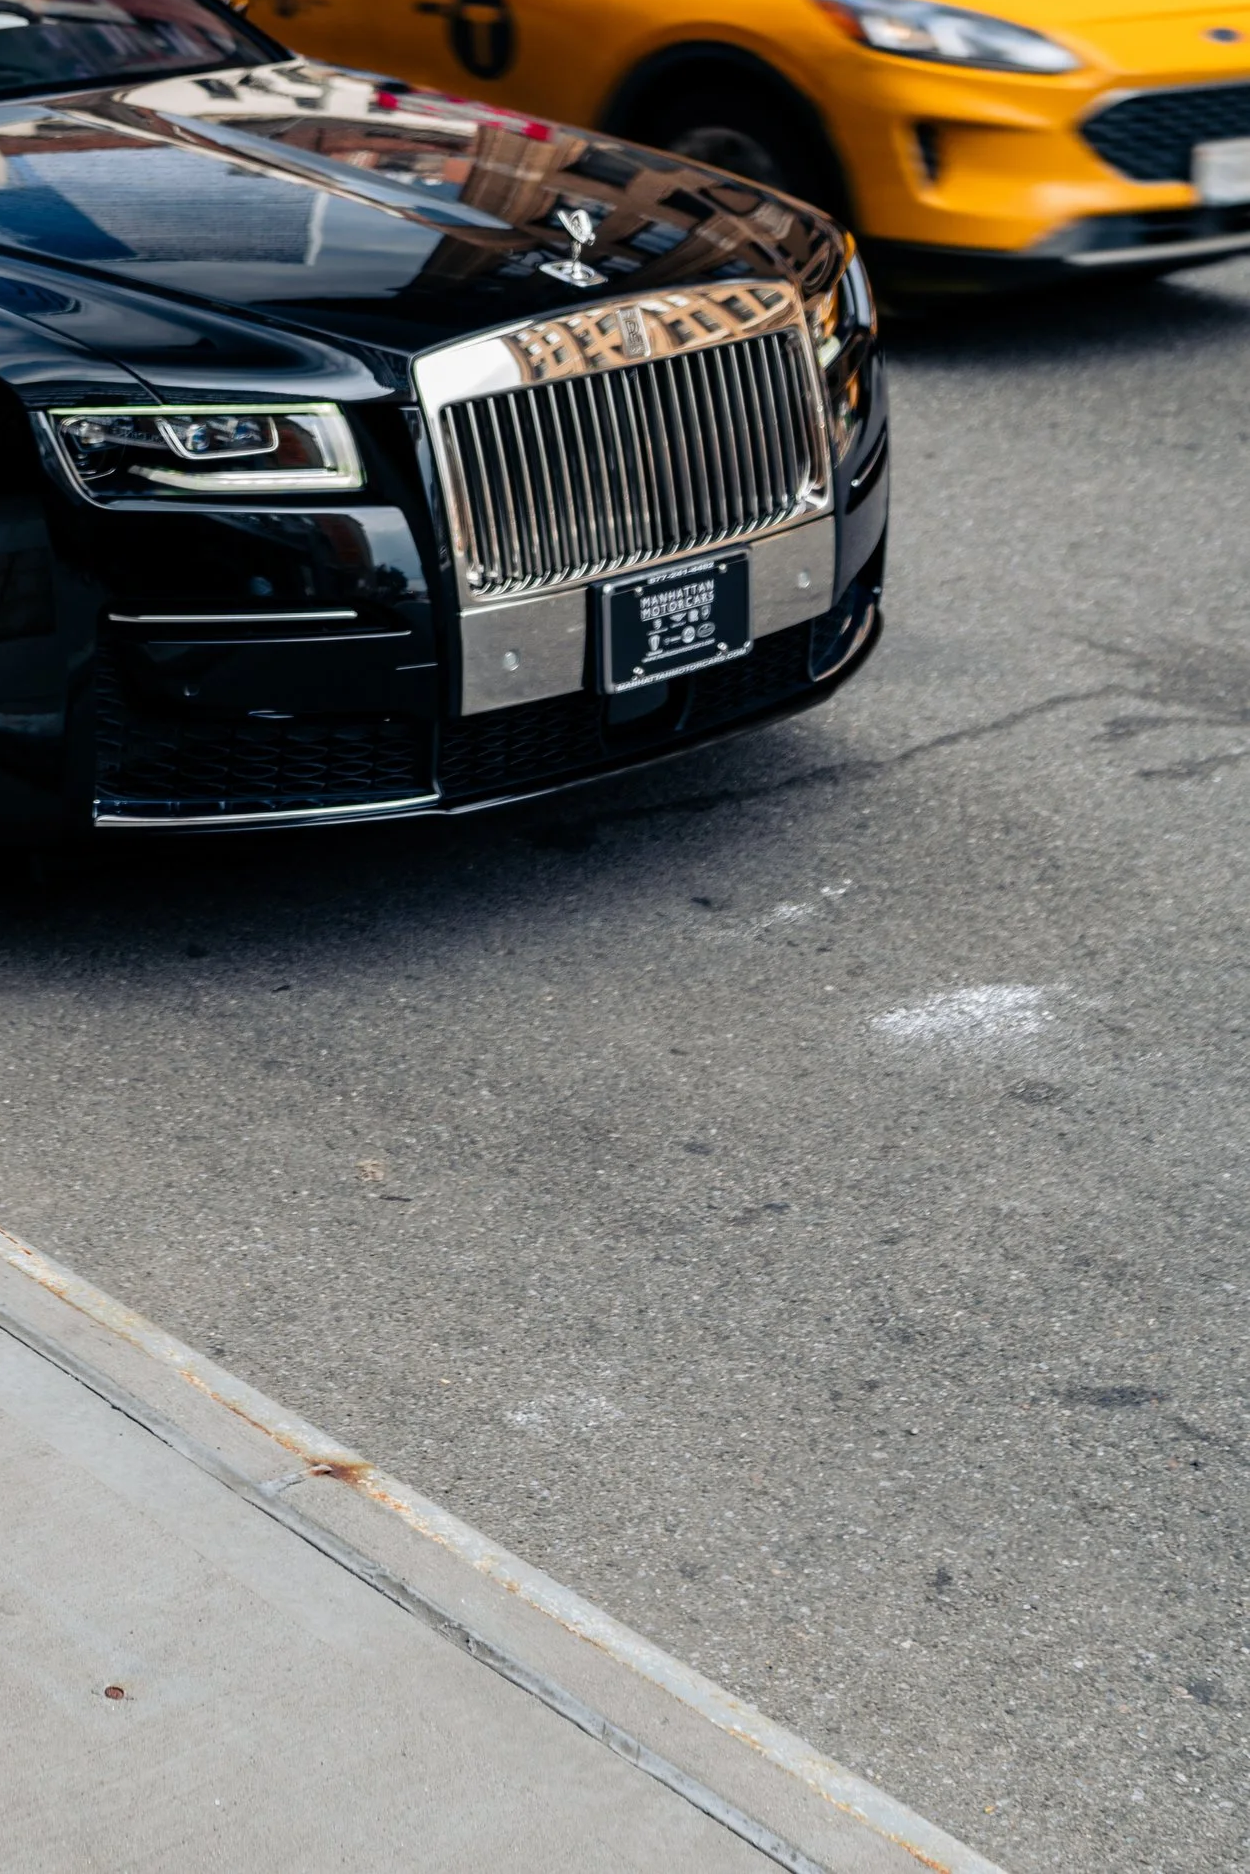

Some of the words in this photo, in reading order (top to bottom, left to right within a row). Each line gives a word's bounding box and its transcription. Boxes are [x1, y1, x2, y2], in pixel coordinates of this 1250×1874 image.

[641, 580, 714, 608] MANHATTAN
[641, 592, 714, 619] MOTORCARS
[615, 648, 748, 692] MANHATTANMOTORCARS.COM
